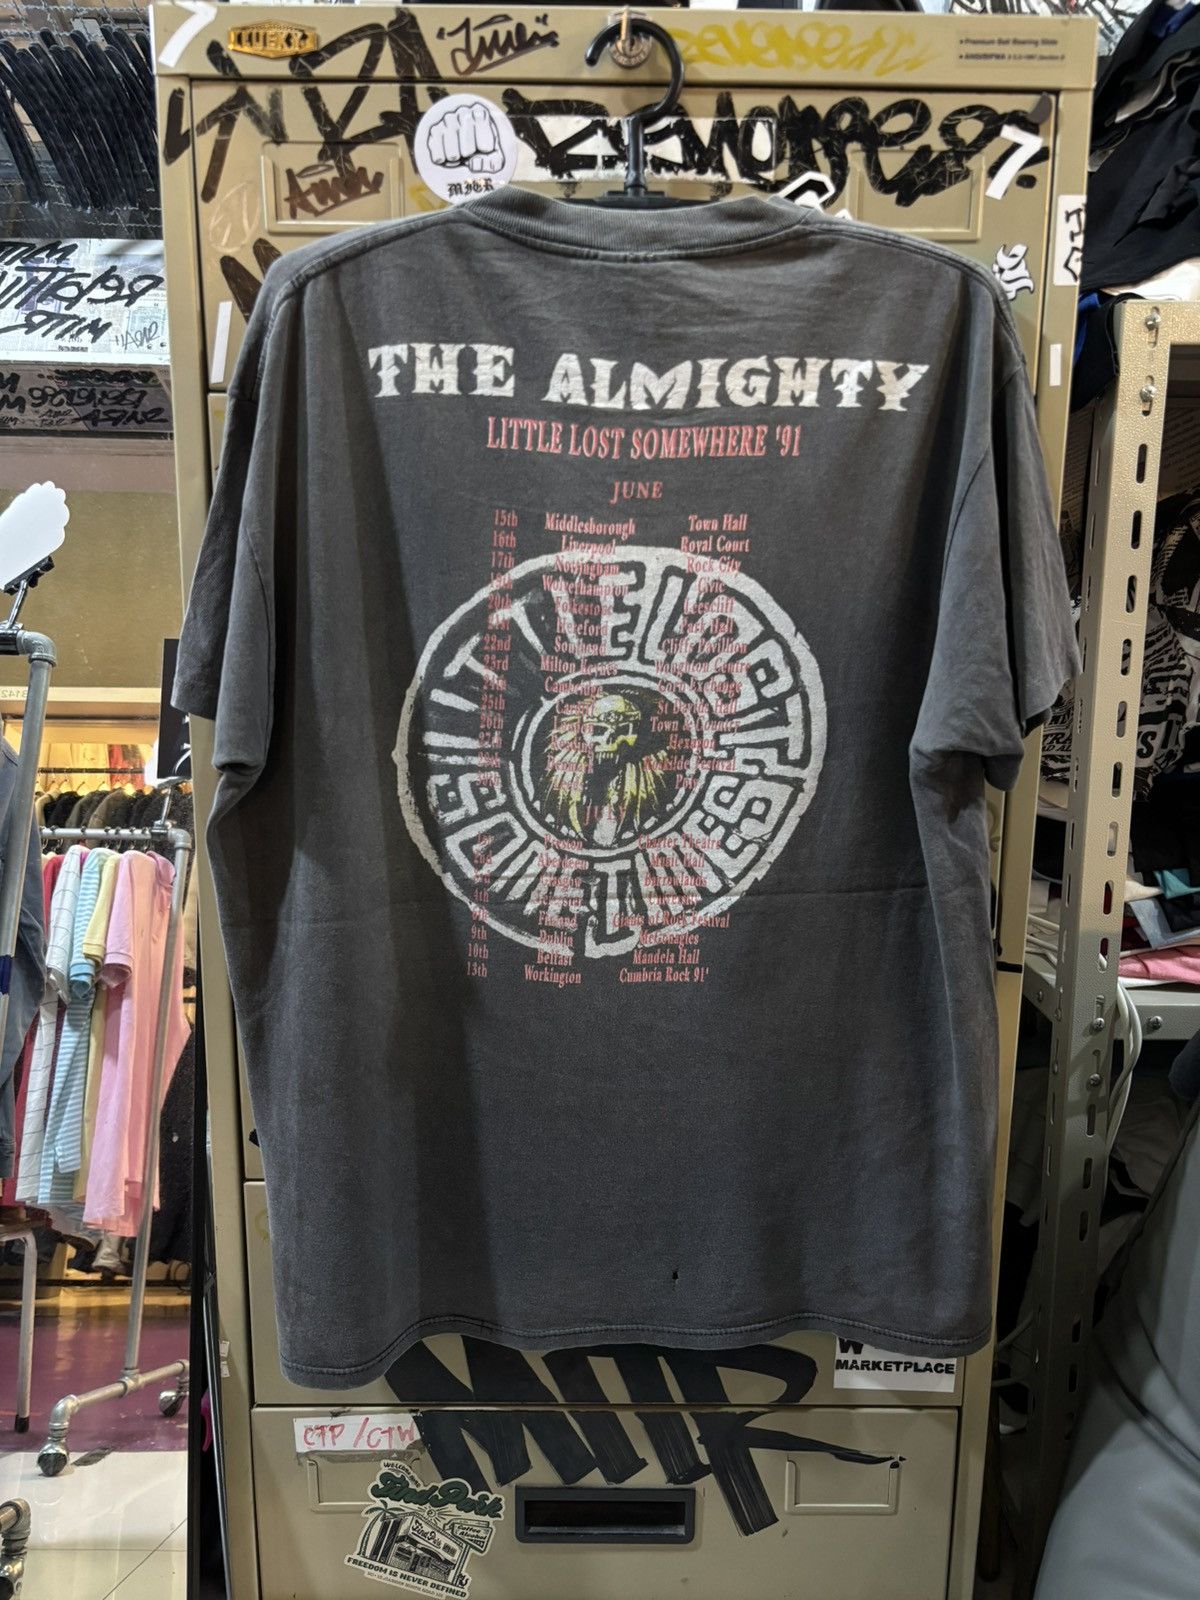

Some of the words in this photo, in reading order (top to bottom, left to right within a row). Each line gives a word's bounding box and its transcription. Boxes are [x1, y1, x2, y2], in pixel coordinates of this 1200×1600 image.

[368, 342, 515, 398] THE
[541, 353, 930, 412] ALMIGHTY
[487, 416, 563, 454] LITTLE
[568, 423, 625, 459] LOST
[630, 425, 768, 460] SOMEWHERE
[775, 424, 802, 457] '91
[609, 481, 663, 505] JUNE
[493, 509, 518, 527] 15th
[544, 512, 636, 540] Middlesborough
[688, 514, 718, 531] Town
[722, 514, 749, 531] Hall
[492, 530, 516, 548] 16th
[561, 535, 616, 559] Liverpool
[680, 536, 713, 554] Royal
[717, 536, 750, 552] Court
[491, 551, 515, 568] 17th
[555, 555, 620, 580] Nottingham
[685, 556, 713, 574] Rock
[718, 556, 741, 577] City
[556, 617, 609, 637] Hereford
[483, 635, 511, 652] 22nd
[540, 655, 576, 673] Milton
[650, 716, 679, 732] Town
[663, 910, 688, 928] Rock
[691, 911, 731, 928] Festival
[470, 924, 488, 941] 9th
[539, 929, 574, 947] Dublin
[467, 943, 489, 959] 10th
[536, 950, 574, 966] Belfast
[632, 949, 675, 965] Mandela
[678, 948, 700, 965] Hall
[466, 961, 488, 978] 13th
[524, 964, 582, 988] Workington
[619, 967, 662, 983] Cumbria
[665, 967, 690, 983] Rock
[835, 1359, 955, 1375] MARKETPLACE
[347, 1556, 388, 1575] FREEDOM
[388, 1569, 399, 1578] IS
[399, 1573, 429, 1588] NEVER
[429, 1582, 467, 1599] DEFINED
